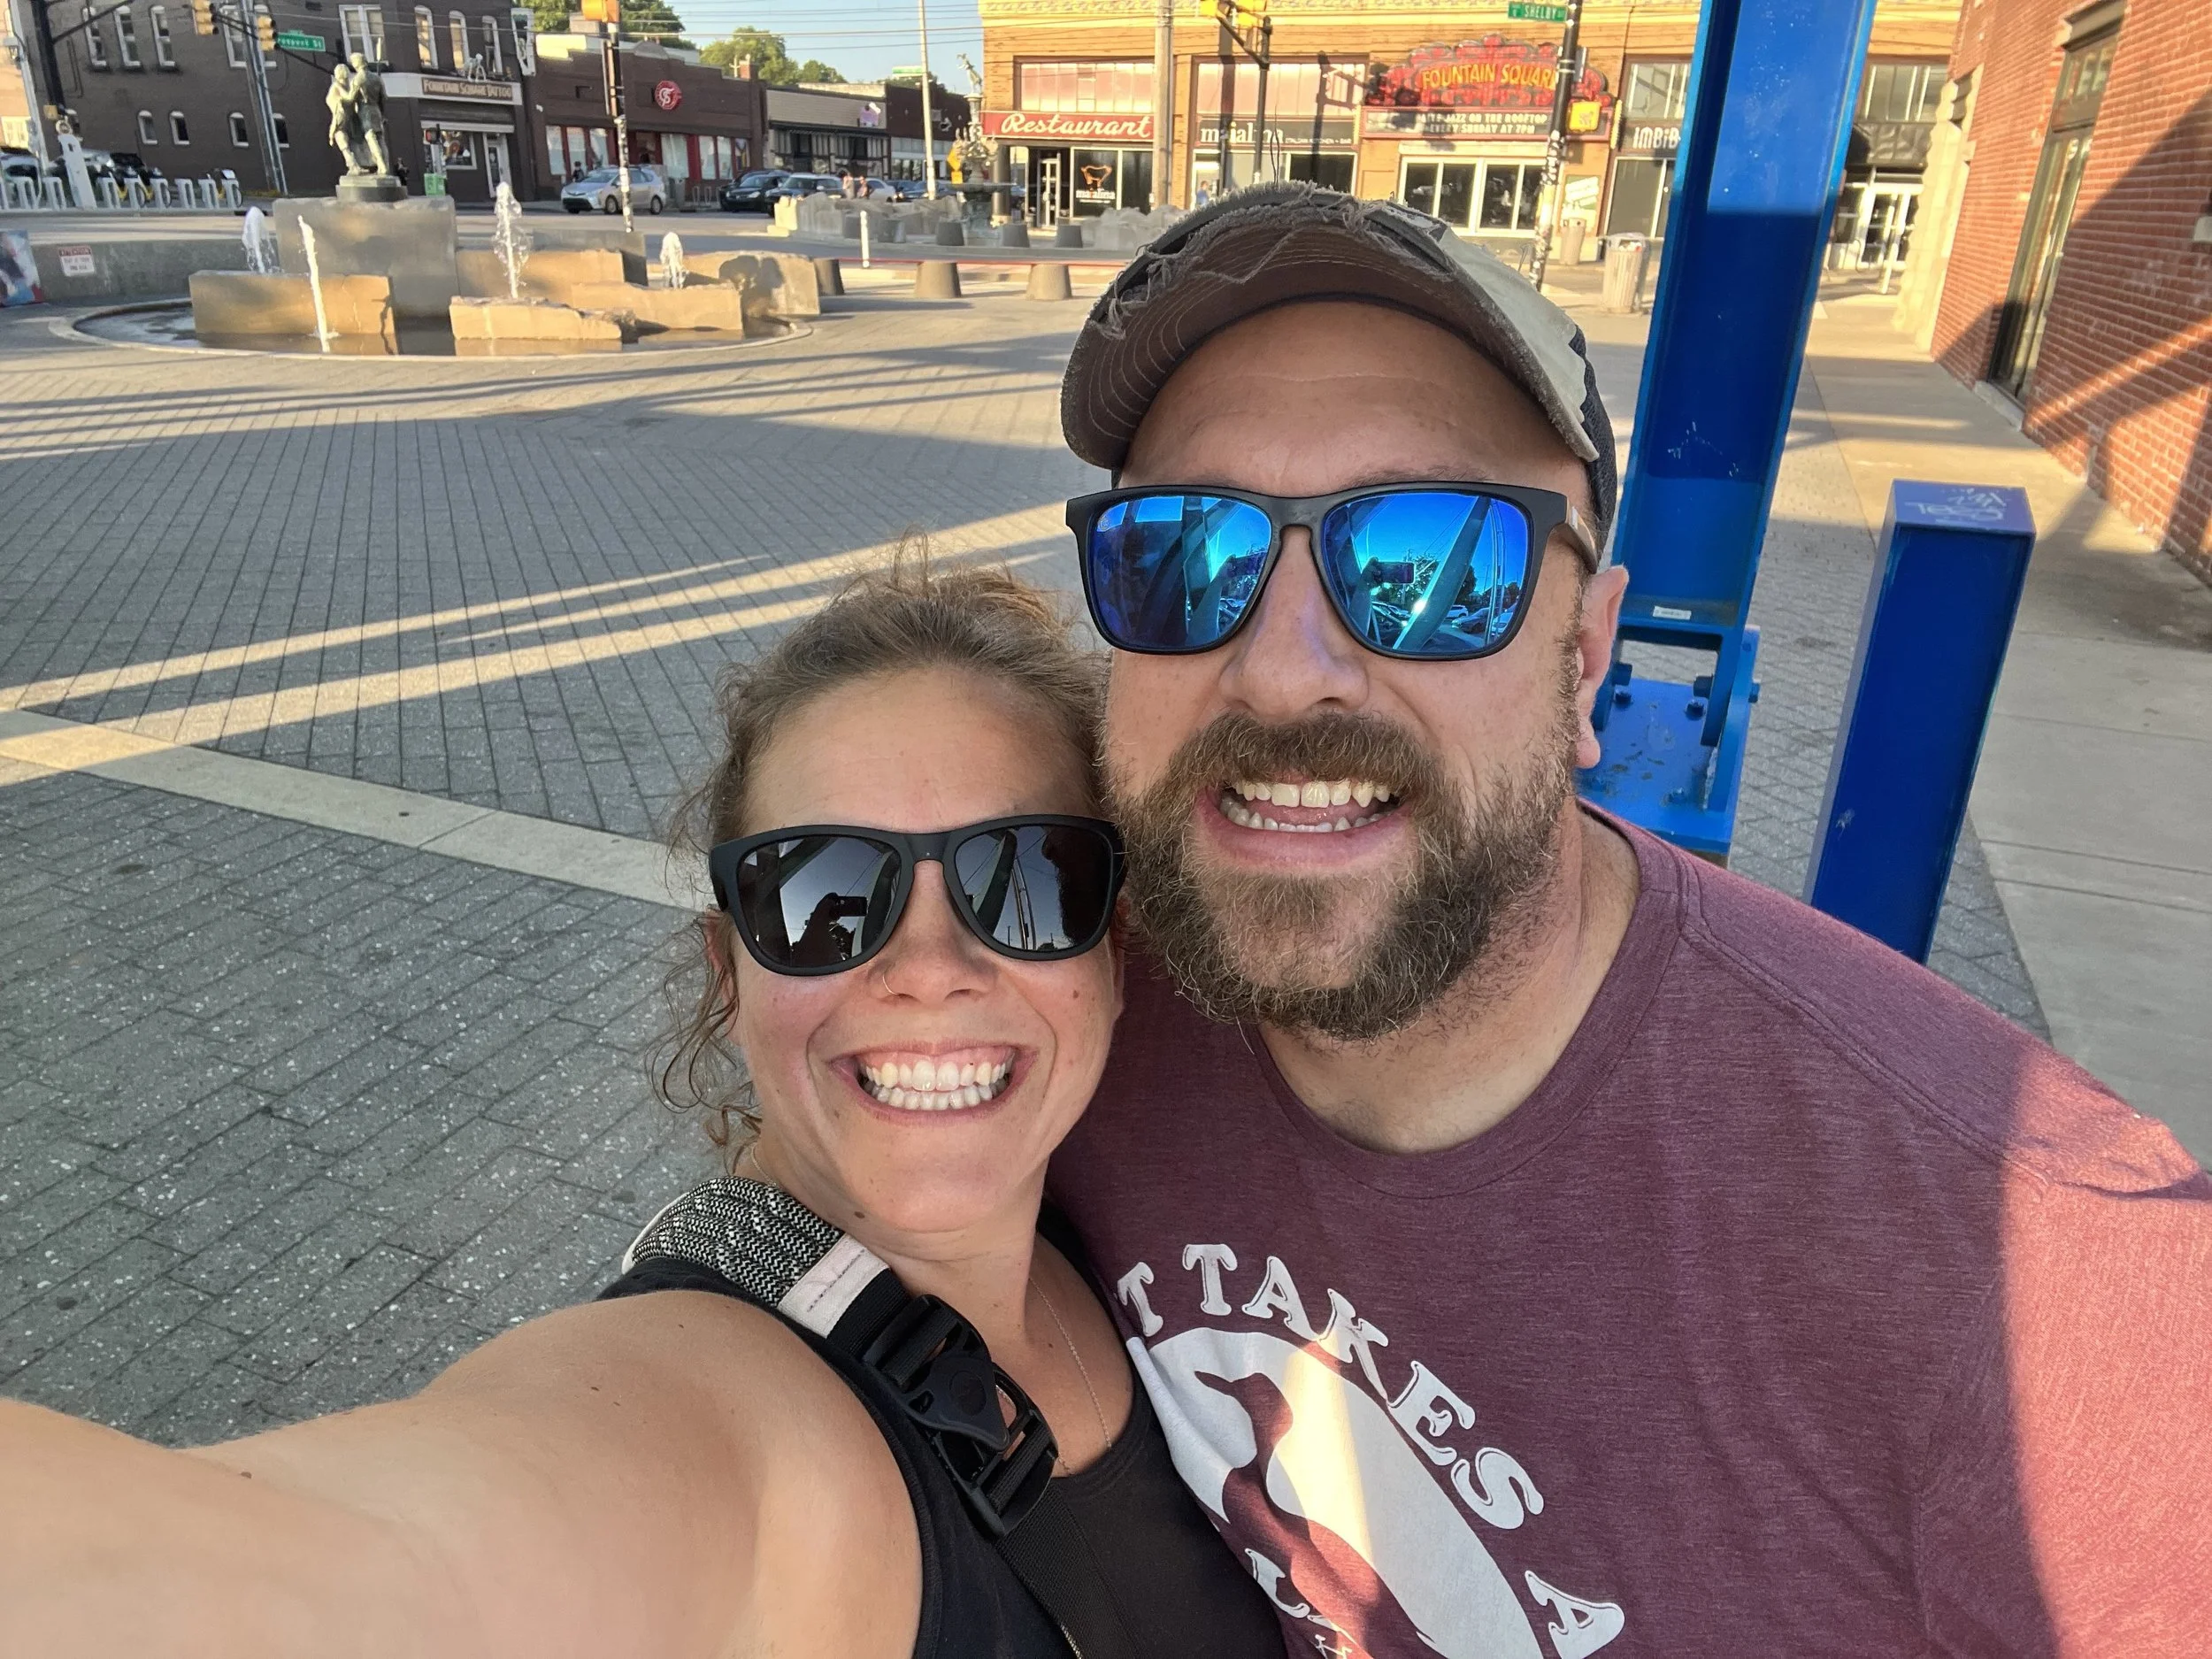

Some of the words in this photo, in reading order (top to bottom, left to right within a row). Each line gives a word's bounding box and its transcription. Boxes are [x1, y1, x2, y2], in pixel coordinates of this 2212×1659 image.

[1525, 4, 1557, 19] SHELBY
[1421, 63, 1496, 90] FOUNTAIN
[1001, 112, 1152, 138] Restaurant
[1444, 112, 1467, 123] JAZZ
[1469, 112, 1482, 123] ON
[1485, 112, 1502, 123] THE
[1504, 112, 1548, 124] ROOFTOP
[1461, 123, 1498, 134] SUNDAY
[1500, 123, 1513, 134] AT
[1516, 124, 1535, 134] 7PM
[1182, 1243, 1545, 1531] TAKES
[1527, 1570, 1625, 1659] A
